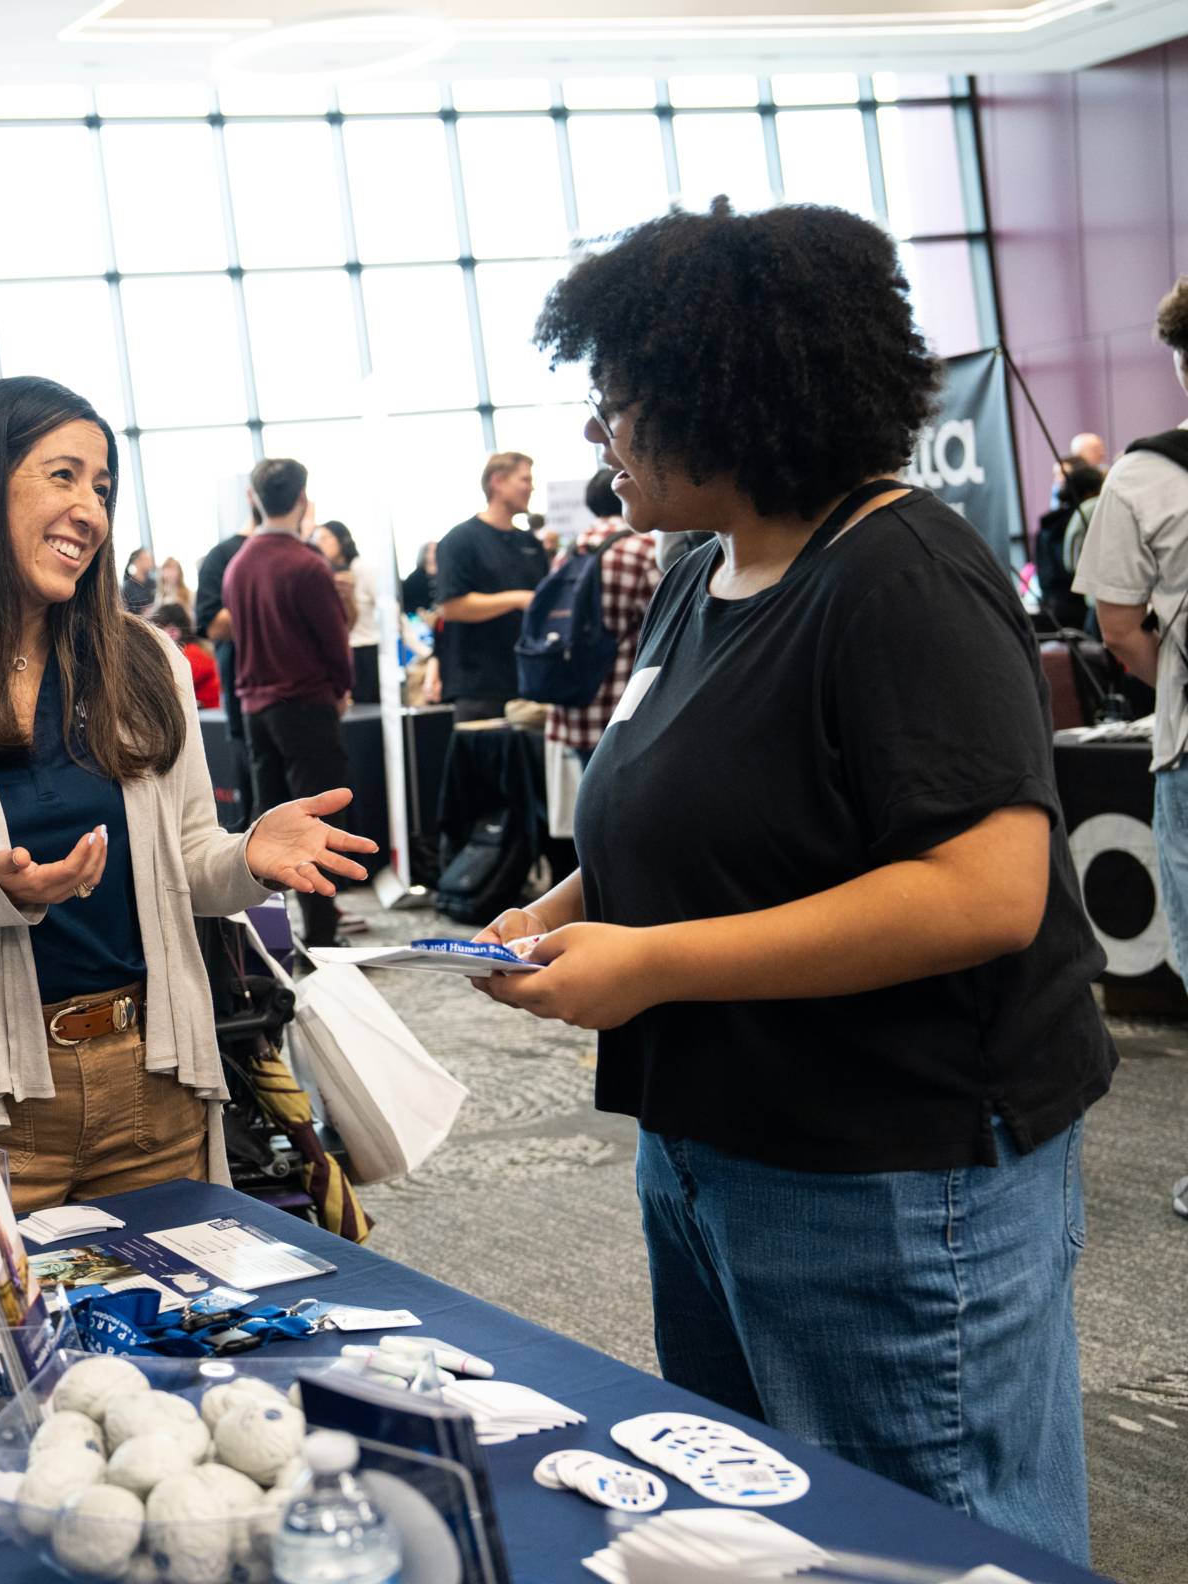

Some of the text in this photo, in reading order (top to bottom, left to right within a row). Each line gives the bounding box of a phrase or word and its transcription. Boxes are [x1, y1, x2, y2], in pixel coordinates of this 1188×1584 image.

[429, 943, 447, 952] and
[449, 943, 487, 954] Human
[90, 1317, 137, 1345] SPARC
